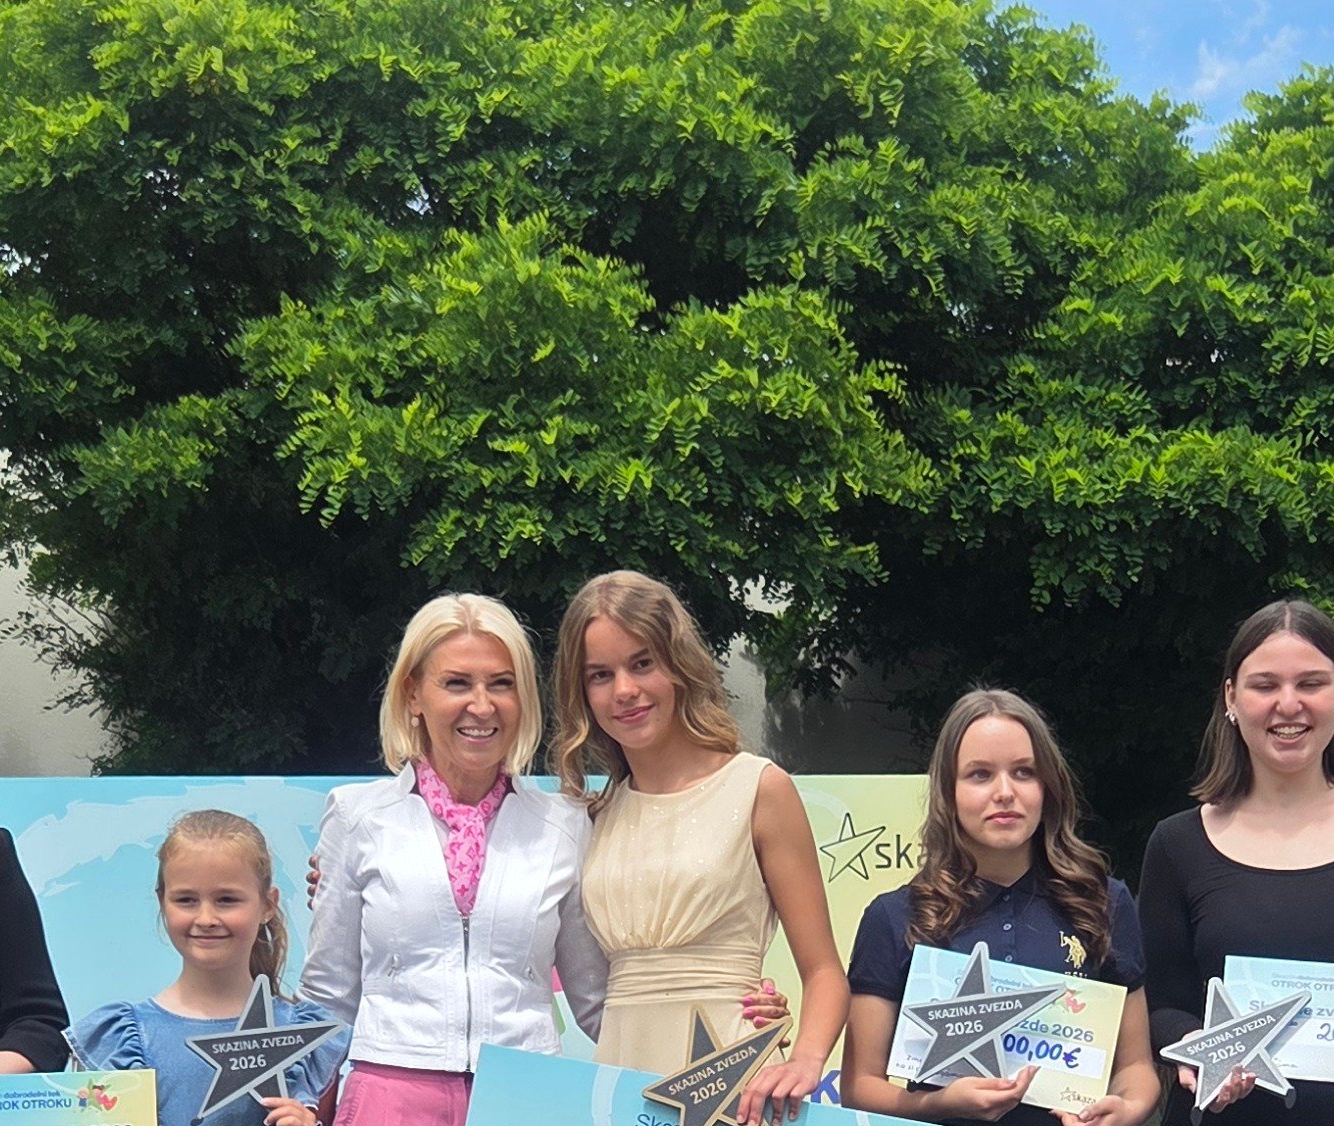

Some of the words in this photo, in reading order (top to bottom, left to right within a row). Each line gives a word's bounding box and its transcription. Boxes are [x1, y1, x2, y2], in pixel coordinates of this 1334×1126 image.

[1271, 979, 1311, 990] OTROK
[928, 1005, 977, 1021] SKAZINA
[978, 999, 1023, 1014] ZVEZDA
[945, 1020, 984, 1037] 2026
[1019, 1018, 1049, 1034] zde
[1051, 1024, 1095, 1042] 2026
[1187, 1031, 1233, 1055] SKAZINA
[1233, 1014, 1276, 1038] ZVEZDA
[212, 1039, 259, 1054] SKAZINA
[261, 1035, 305, 1049] ZVEZDA
[1003, 1033, 1082, 1069] 00,00€
[1208, 1041, 1246, 1065] 2026
[229, 1054, 267, 1071] 2026
[668, 1066, 715, 1096] SKAZINA
[716, 1045, 757, 1073] ZVEZDA
[690, 1077, 728, 1105] 2026
[22, 1099, 72, 1110] OTROKU
